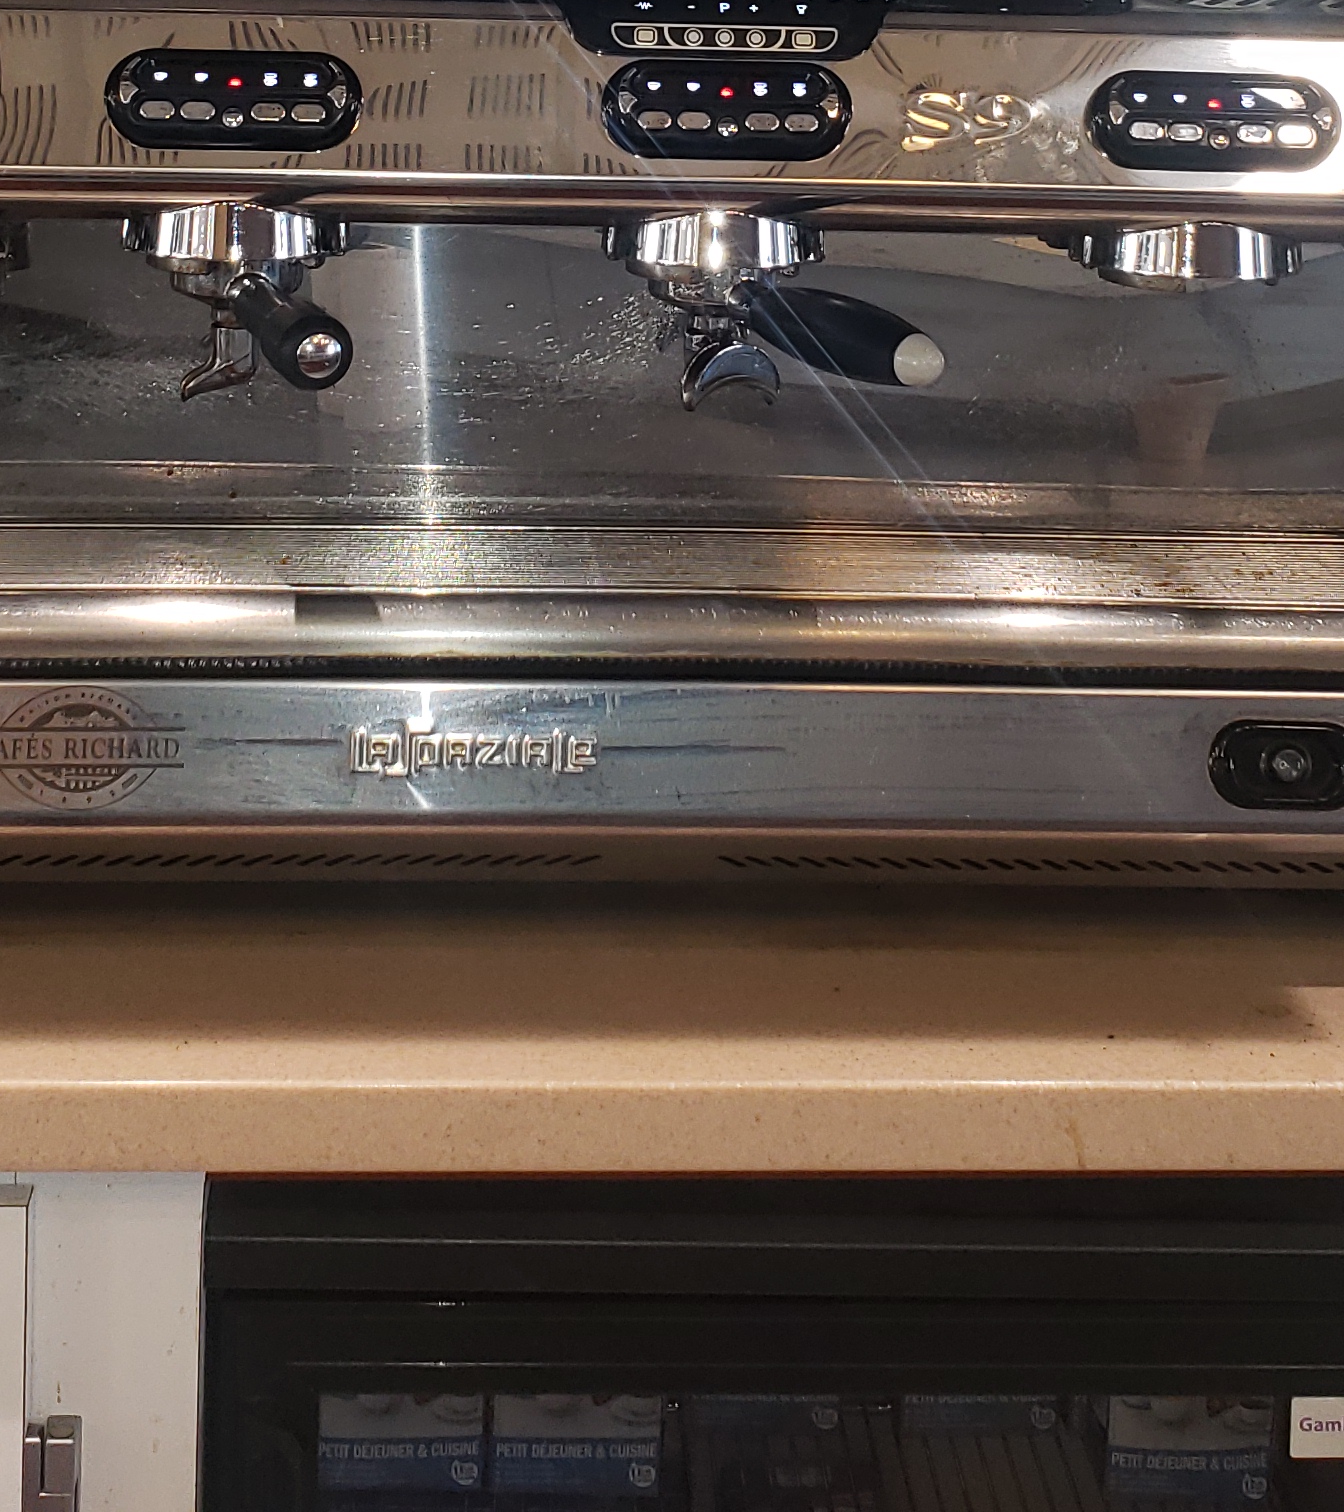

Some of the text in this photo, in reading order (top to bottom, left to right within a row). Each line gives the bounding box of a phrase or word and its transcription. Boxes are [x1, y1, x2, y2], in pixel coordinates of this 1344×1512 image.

[719, 3, 730, 14] P
[63, 737, 180, 760] RICHARD
[318, 1442, 350, 1458] PETIT
[431, 1440, 480, 1456] CUISINE
[496, 1443, 529, 1459] PETIT
[609, 1443, 658, 1459] CUISINE
[1111, 1451, 1144, 1469] PETIT
[1223, 1453, 1268, 1471] CUISINE
